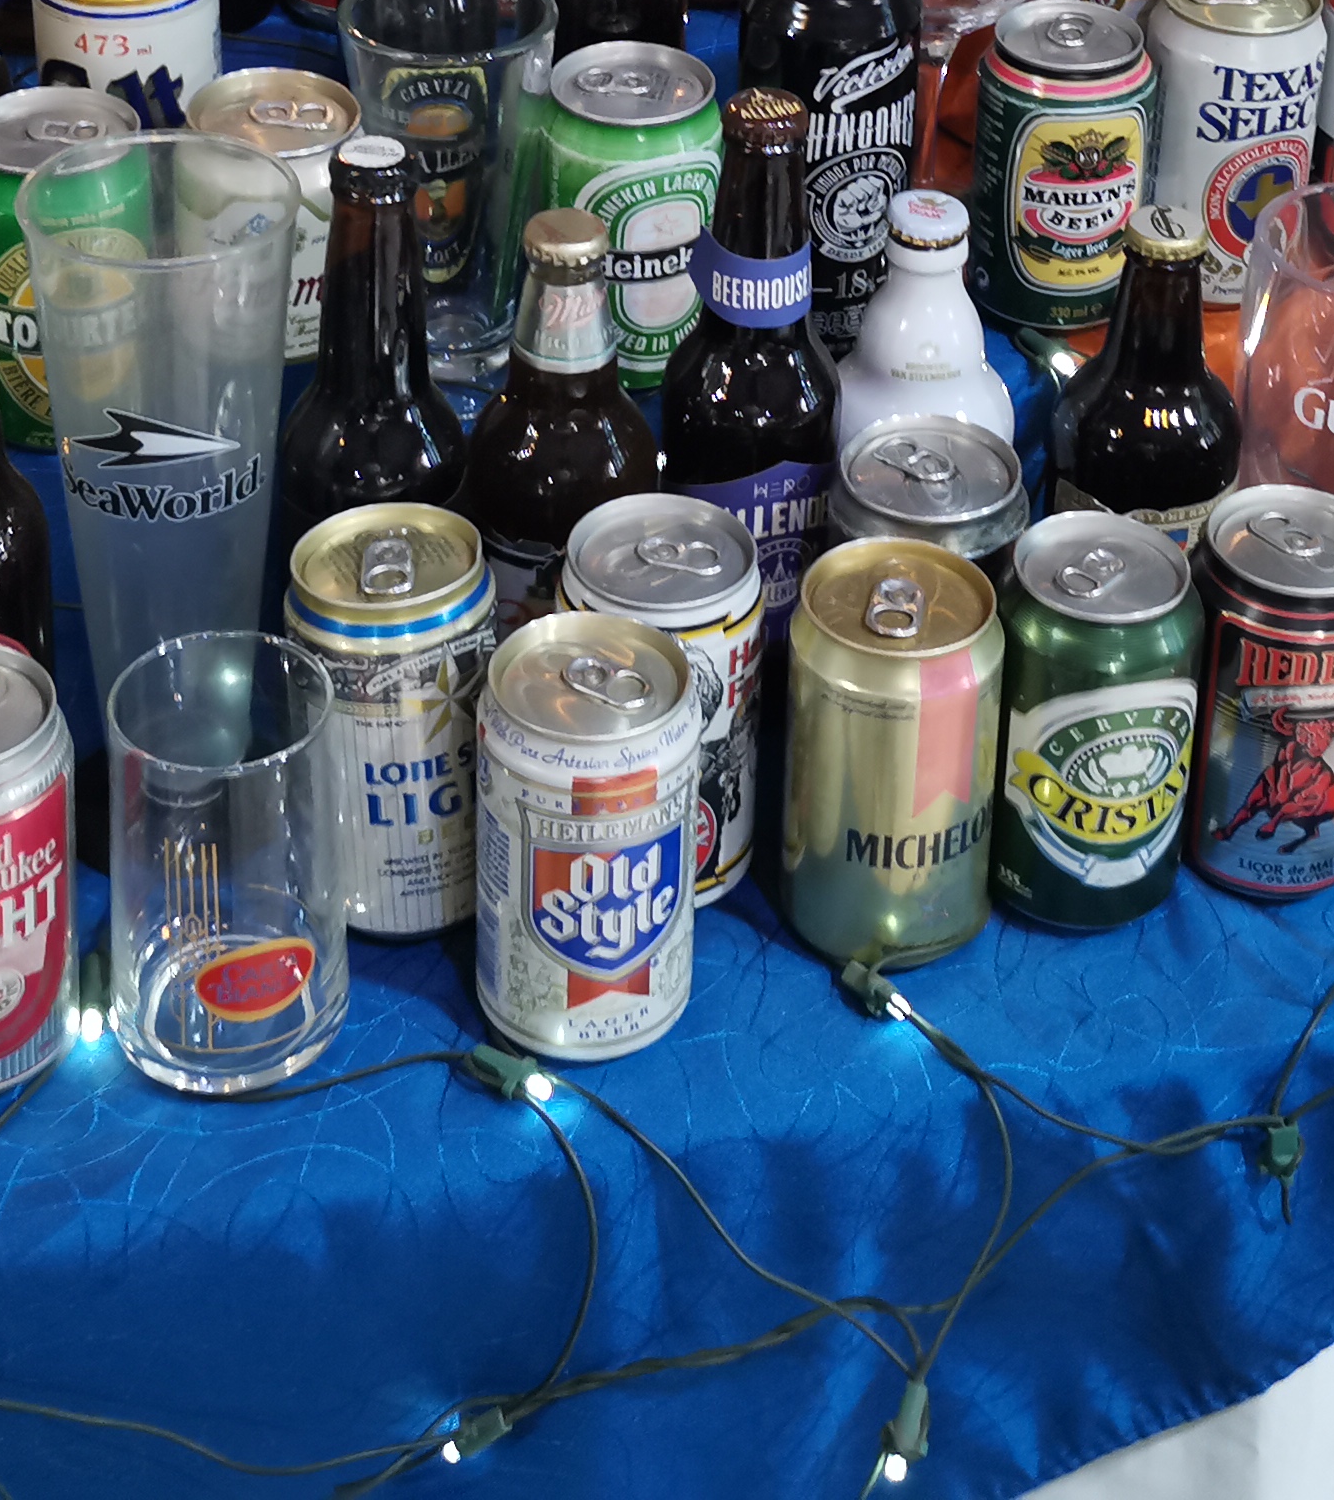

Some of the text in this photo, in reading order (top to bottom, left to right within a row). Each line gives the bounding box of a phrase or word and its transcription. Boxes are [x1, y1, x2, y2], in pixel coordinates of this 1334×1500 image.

[73, 34, 153, 57] 473 ml
[1214, 46, 1326, 102] TEXAS
[1196, 101, 1316, 145] SELEC
[1048, 207, 1116, 232] BEER
[61, 452, 262, 524] SeaWorld
[1236, 636, 1319, 688] RED
[1045, 707, 1193, 758] CERVEZA
[365, 756, 451, 787] LONE
[366, 782, 462, 828] LIG
[846, 807, 991, 868] MICHELO
[570, 841, 661, 902] Old
[540, 884, 675, 960] Style
